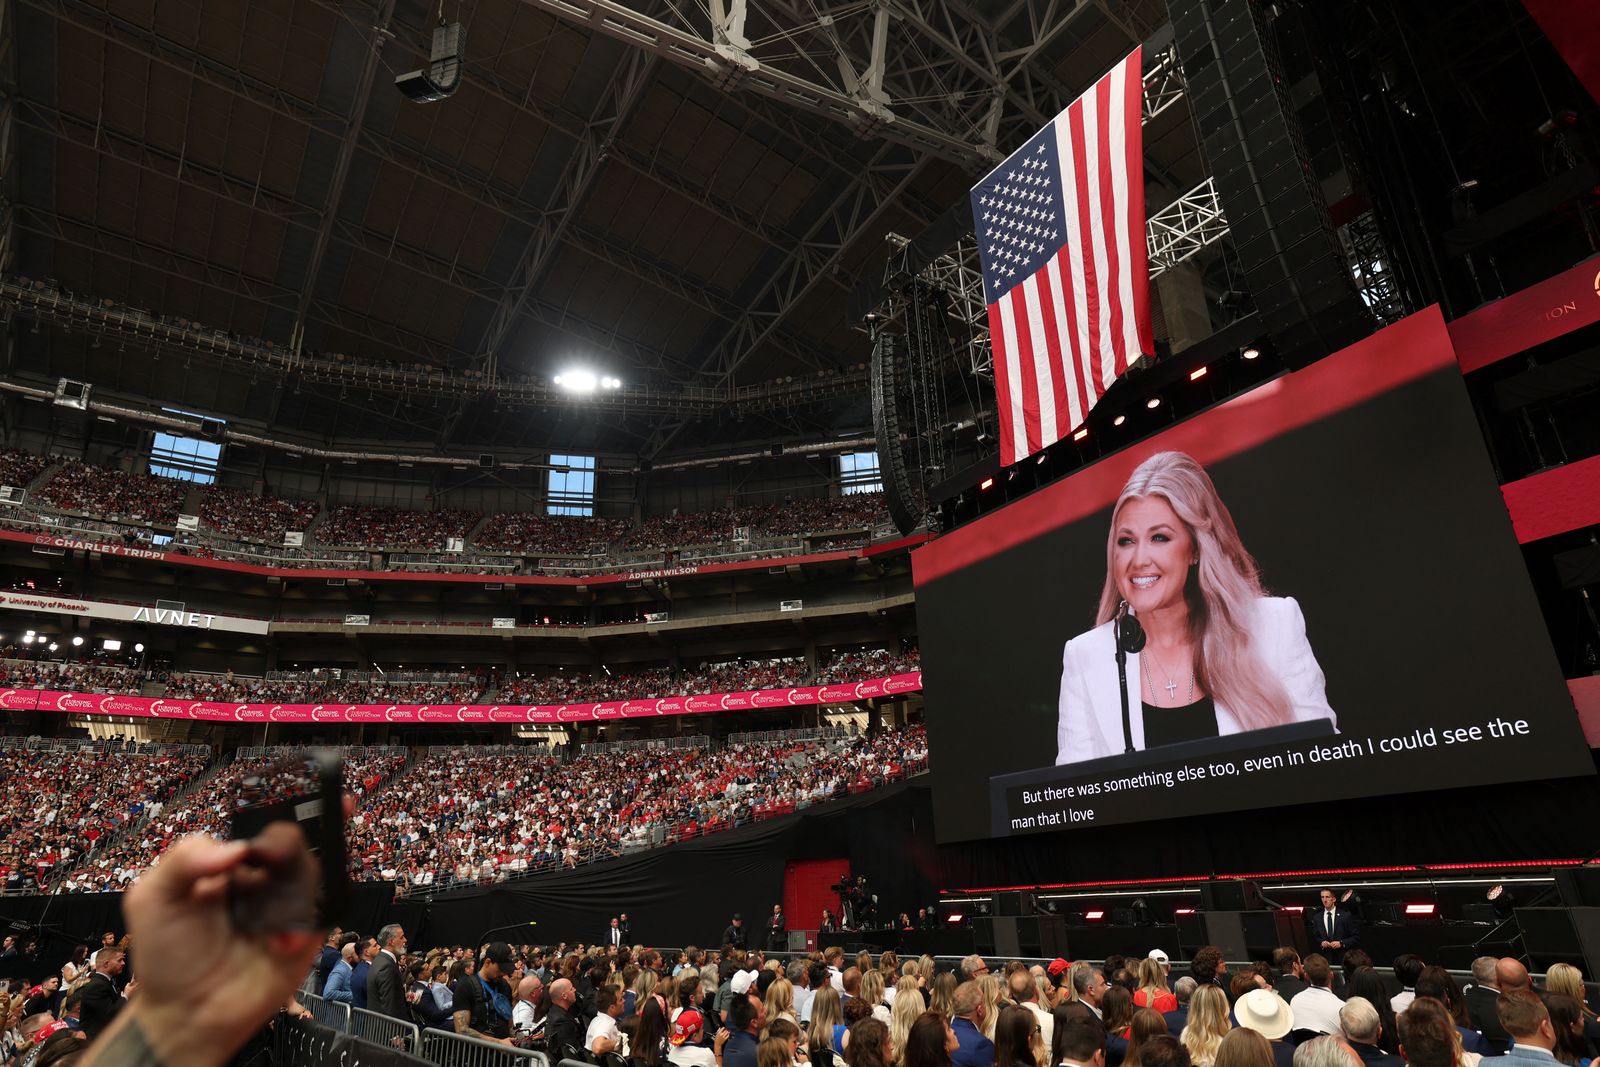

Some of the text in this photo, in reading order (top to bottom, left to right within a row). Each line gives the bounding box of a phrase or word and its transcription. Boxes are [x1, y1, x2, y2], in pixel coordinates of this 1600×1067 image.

[54, 538, 120, 554] CHARLEY
[123, 547, 165, 561] TRIPPI
[629, 571, 661, 579] ADRIAN
[664, 567, 697, 576] WILSON
[8, 597, 49, 609] University
[57, 602, 86, 612] Phoenix
[133, 607, 215, 628] AVNET
[1022, 718, 1529, 804] But there was something else too, even in death I could see the
[1011, 816, 1035, 829] man
[1037, 811, 1061, 826] that
[1070, 808, 1095, 822] love
